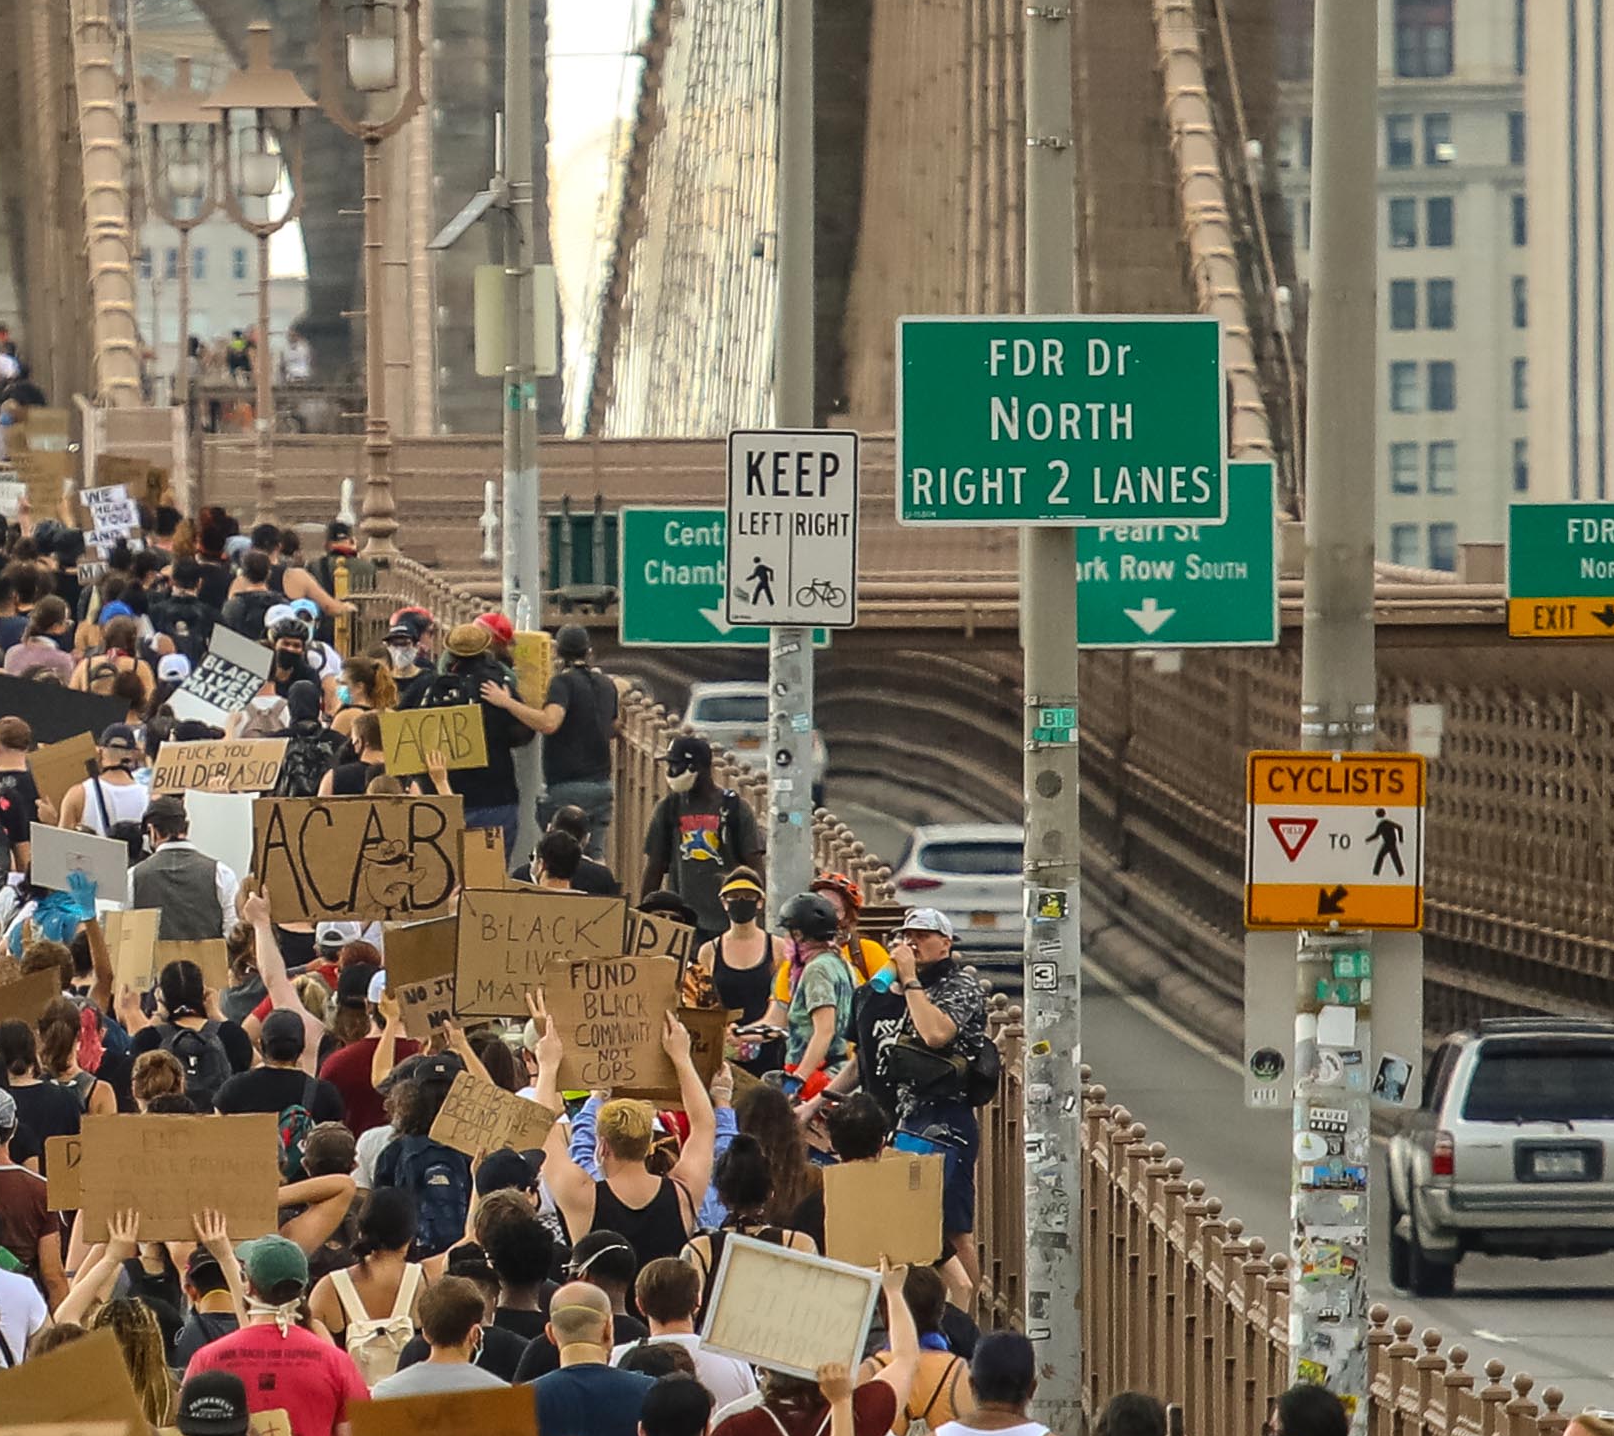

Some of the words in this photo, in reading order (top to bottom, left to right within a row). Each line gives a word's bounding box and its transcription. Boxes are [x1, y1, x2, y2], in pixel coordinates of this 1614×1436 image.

[989, 339, 1064, 377] FDR
[1089, 339, 1131, 377] Dr
[990, 396, 1134, 441] NORTH
[745, 450, 841, 499] KEEP
[912, 467, 1024, 506] RIGHT
[1047, 460, 1070, 505] 2
[1094, 465, 1212, 505] LANES
[85, 490, 114, 505] WE
[99, 514, 132, 526] YOU
[738, 512, 783, 536] LEFT
[795, 513, 850, 536] RIGHT
[665, 521, 726, 546] Cent
[1076, 556, 1110, 582] ark
[1120, 554, 1175, 581] Row
[1534, 605, 1576, 631] EXIT
[192, 668, 250, 703] LIVES
[202, 654, 260, 692] BLACK
[181, 676, 246, 713] MATTER
[394, 713, 471, 762] ACAB
[177, 746, 214, 761] FUCK
[223, 745, 251, 758] YOU
[153, 765, 186, 788] BILL
[1267, 767, 1405, 795] CYCLISTS
[1329, 833, 1351, 850] TO
[260, 803, 455, 917] ACAB
[570, 964, 636, 990] FUND
[404, 985, 428, 1004] NO
[584, 992, 648, 1019] BLACK
[576, 1022, 652, 1048] COMMUNITY
[598, 1049, 631, 1063] NOT
[582, 1064, 637, 1084] COPS
[443, 1095, 498, 1132] DEFUND
[504, 1116, 530, 1136] THE
